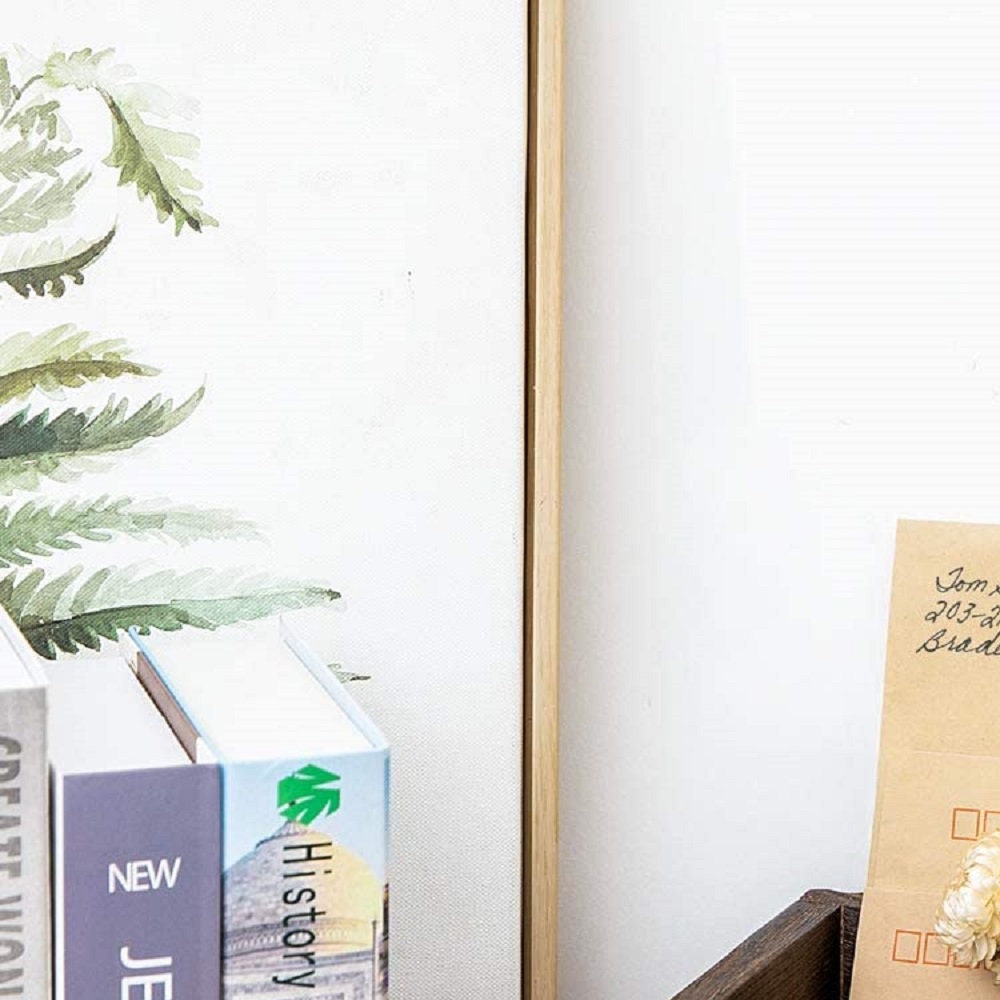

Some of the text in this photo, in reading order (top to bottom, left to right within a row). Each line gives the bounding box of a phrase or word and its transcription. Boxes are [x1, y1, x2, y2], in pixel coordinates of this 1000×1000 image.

[935, 566, 988, 593] Tom
[107, 856, 182, 894] NEW
[272, 841, 333, 989] History
